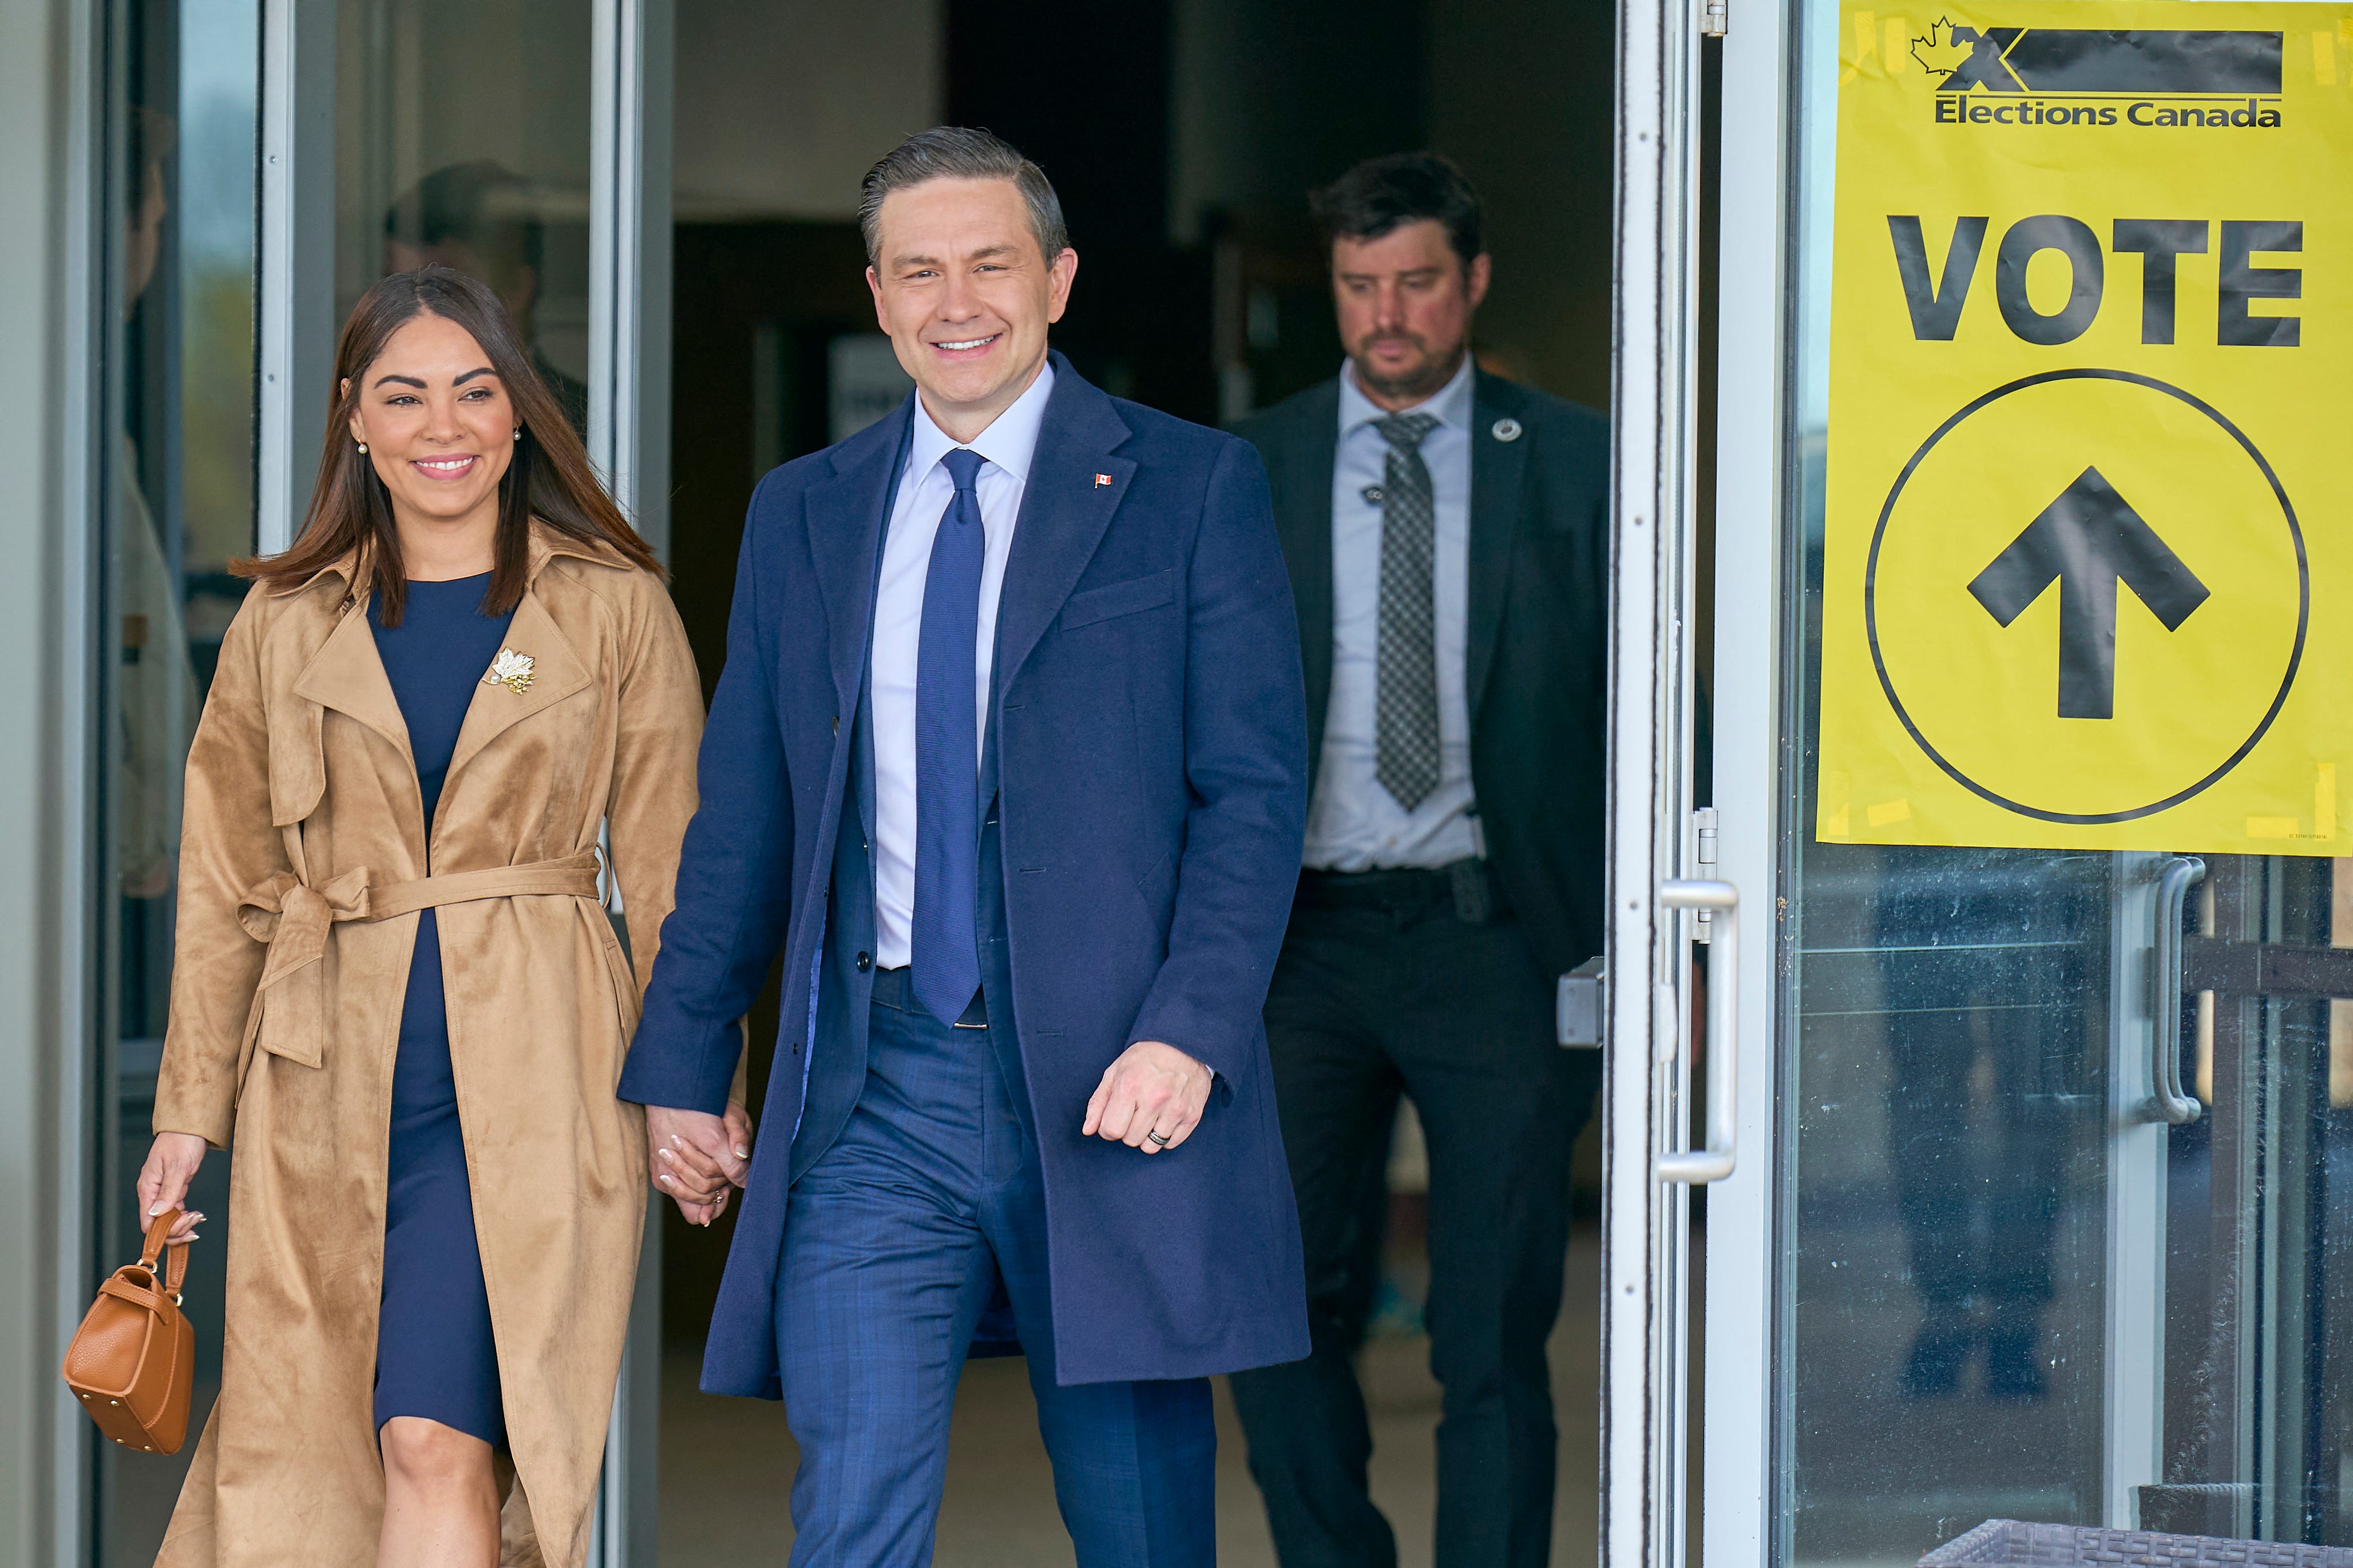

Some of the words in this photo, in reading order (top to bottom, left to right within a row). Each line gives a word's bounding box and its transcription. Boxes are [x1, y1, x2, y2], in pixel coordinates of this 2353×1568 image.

[1935, 94, 2117, 126] Elections
[2127, 98, 2281, 128] Canada
[1886, 215, 2303, 347] VOTE
